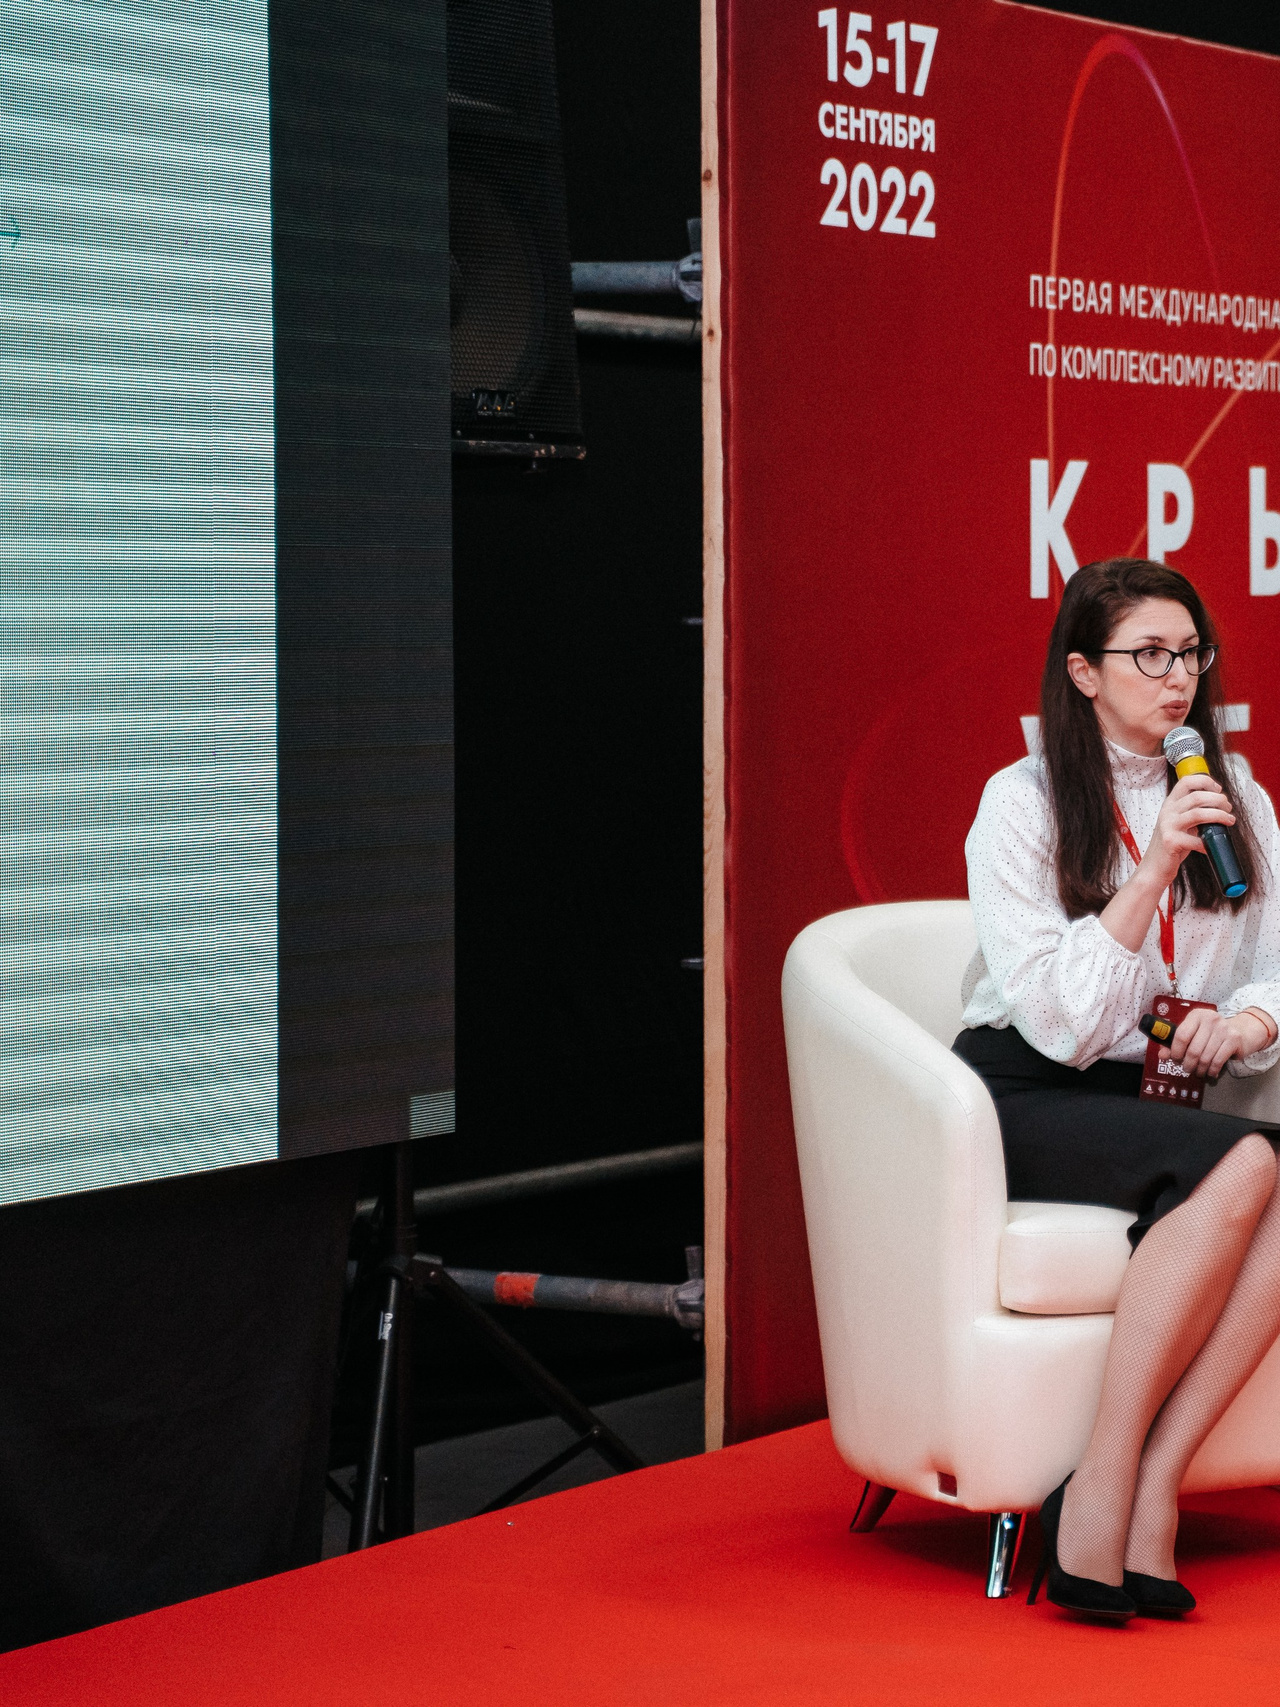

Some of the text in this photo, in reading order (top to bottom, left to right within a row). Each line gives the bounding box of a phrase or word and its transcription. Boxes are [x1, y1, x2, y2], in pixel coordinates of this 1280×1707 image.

[818, 8, 939, 97] 15-17
[818, 102, 936, 153] СЕНТЯБРЯ
[819, 158, 937, 239] 2022
[1029, 274, 1112, 316] ПЕРВАЯ
[1029, 342, 1056, 377] ПО
[1061, 347, 1211, 388] КОМПЛЕКСНОМУ
